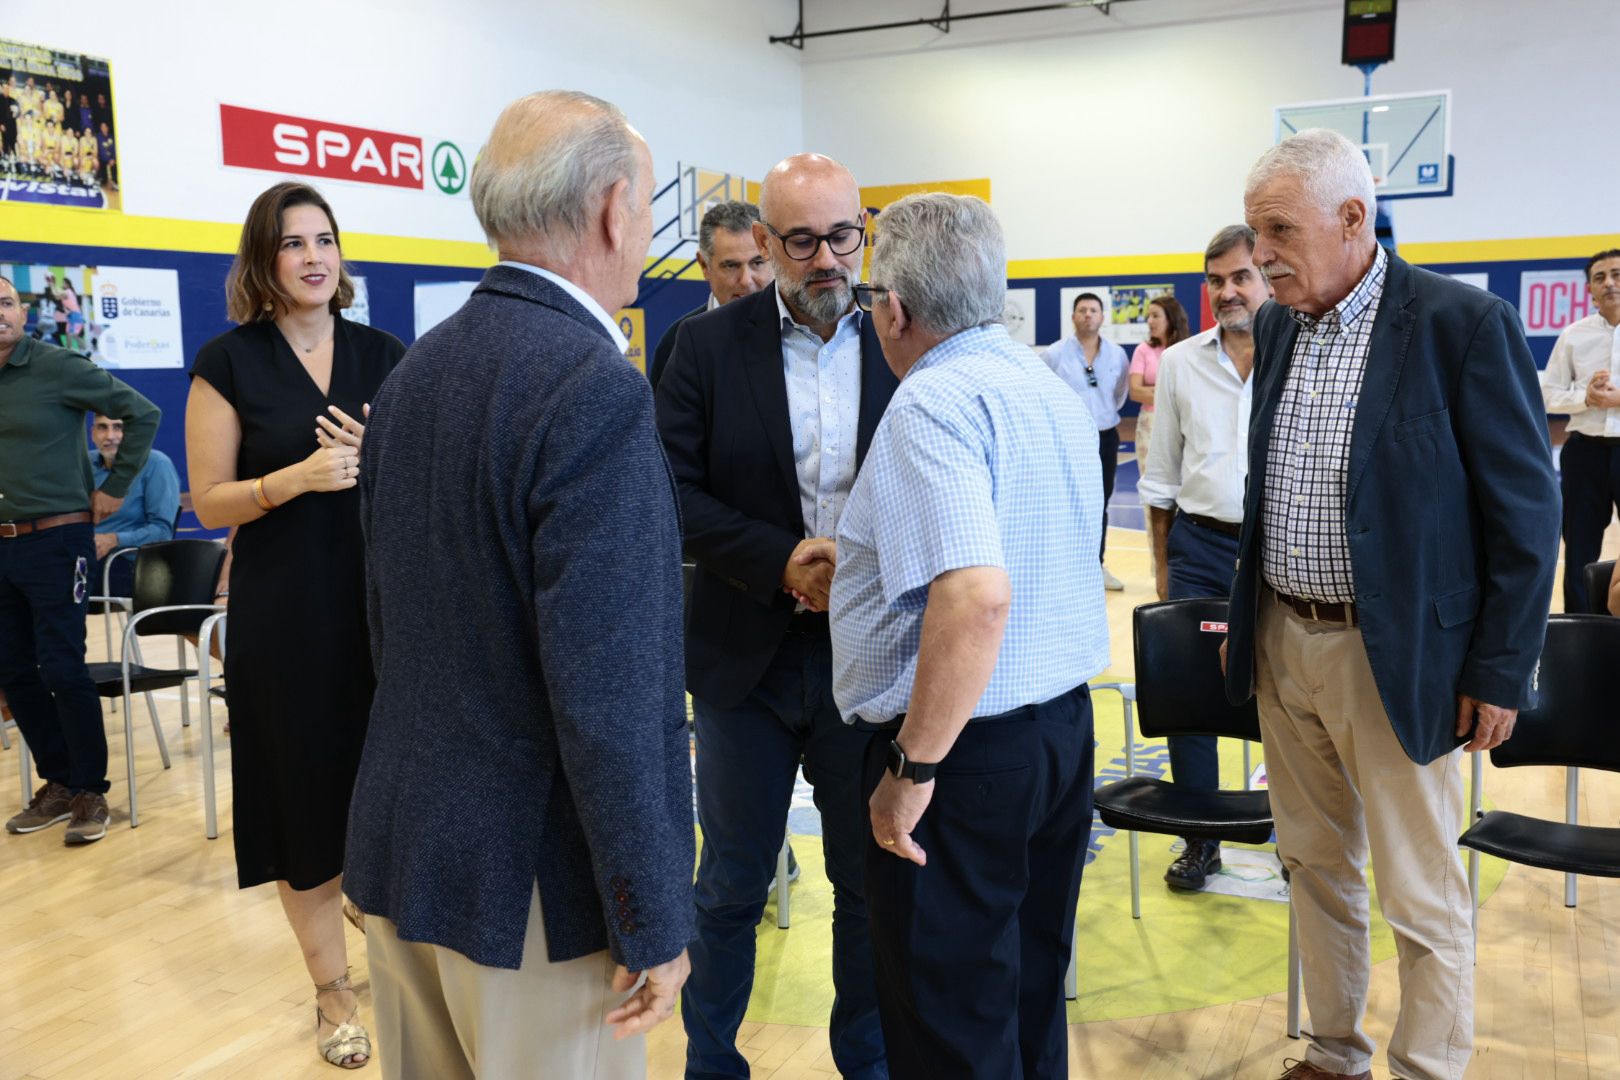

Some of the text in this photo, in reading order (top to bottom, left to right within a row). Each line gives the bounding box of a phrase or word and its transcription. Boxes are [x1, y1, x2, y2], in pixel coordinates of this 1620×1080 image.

[273, 122, 422, 181] SPAR
[121, 296, 161, 307] Gobierno
[122, 307, 171, 317] de Canarias
